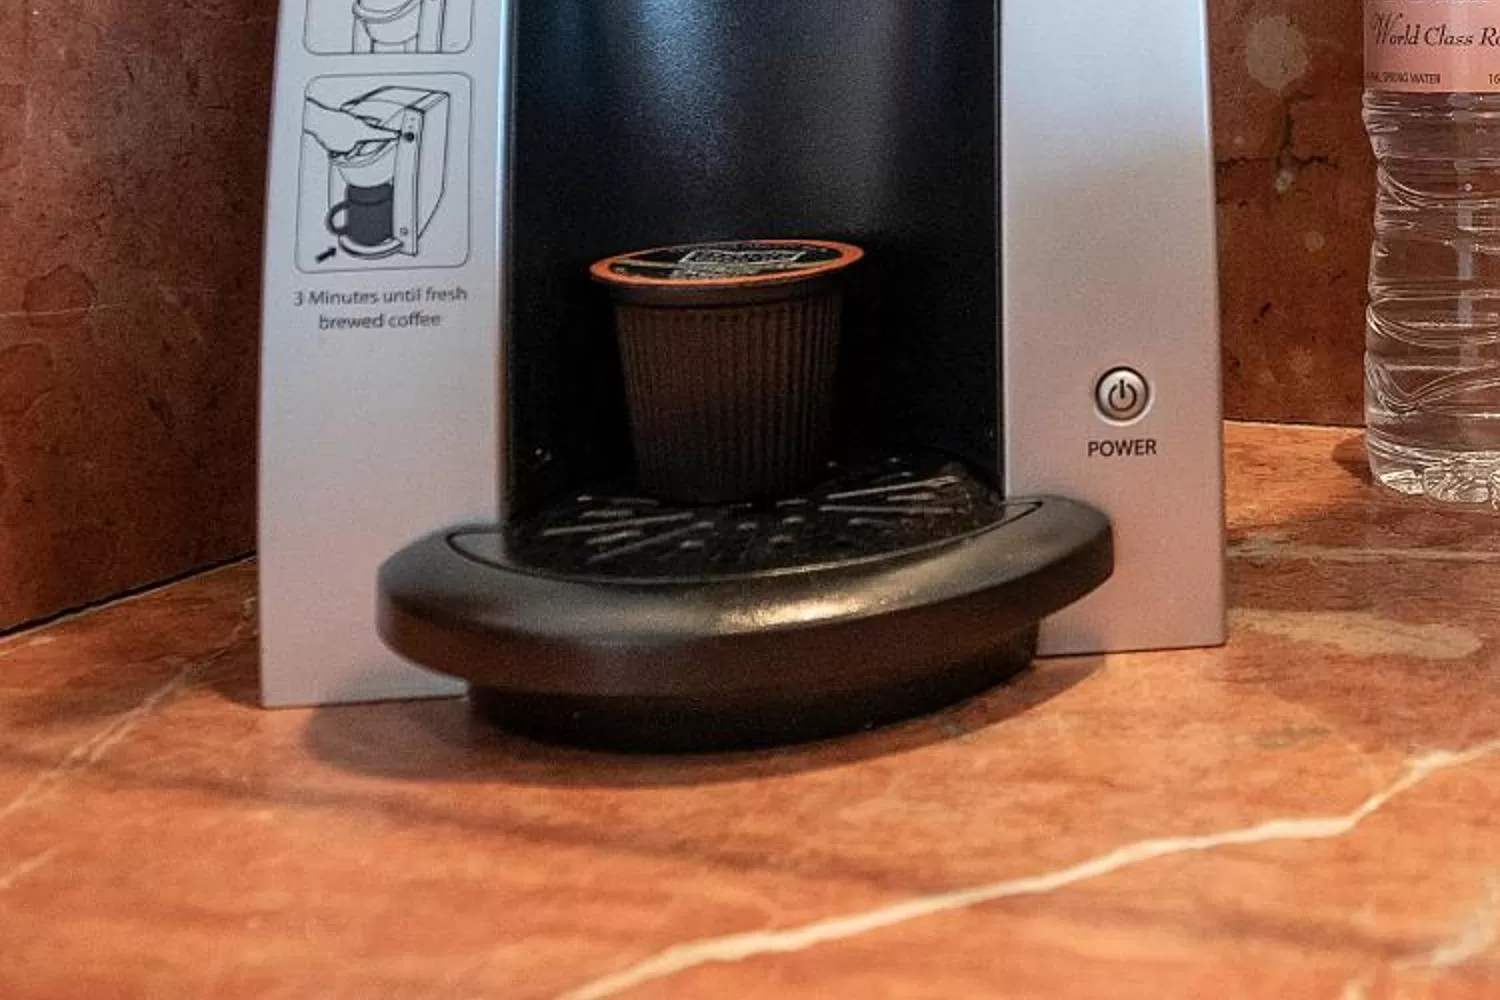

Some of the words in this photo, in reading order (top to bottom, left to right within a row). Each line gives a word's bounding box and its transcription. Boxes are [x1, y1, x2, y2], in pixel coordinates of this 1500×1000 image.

[1371, 11, 1421, 46] World
[1423, 23, 1474, 47] Class
[292, 290, 304, 307] 3
[308, 289, 378, 306] Minutes
[383, 287, 422, 303] until
[425, 285, 468, 302] fresh
[318, 312, 384, 330] brewed
[388, 310, 441, 328] coffee
[1087, 438, 1157, 457] POWER
